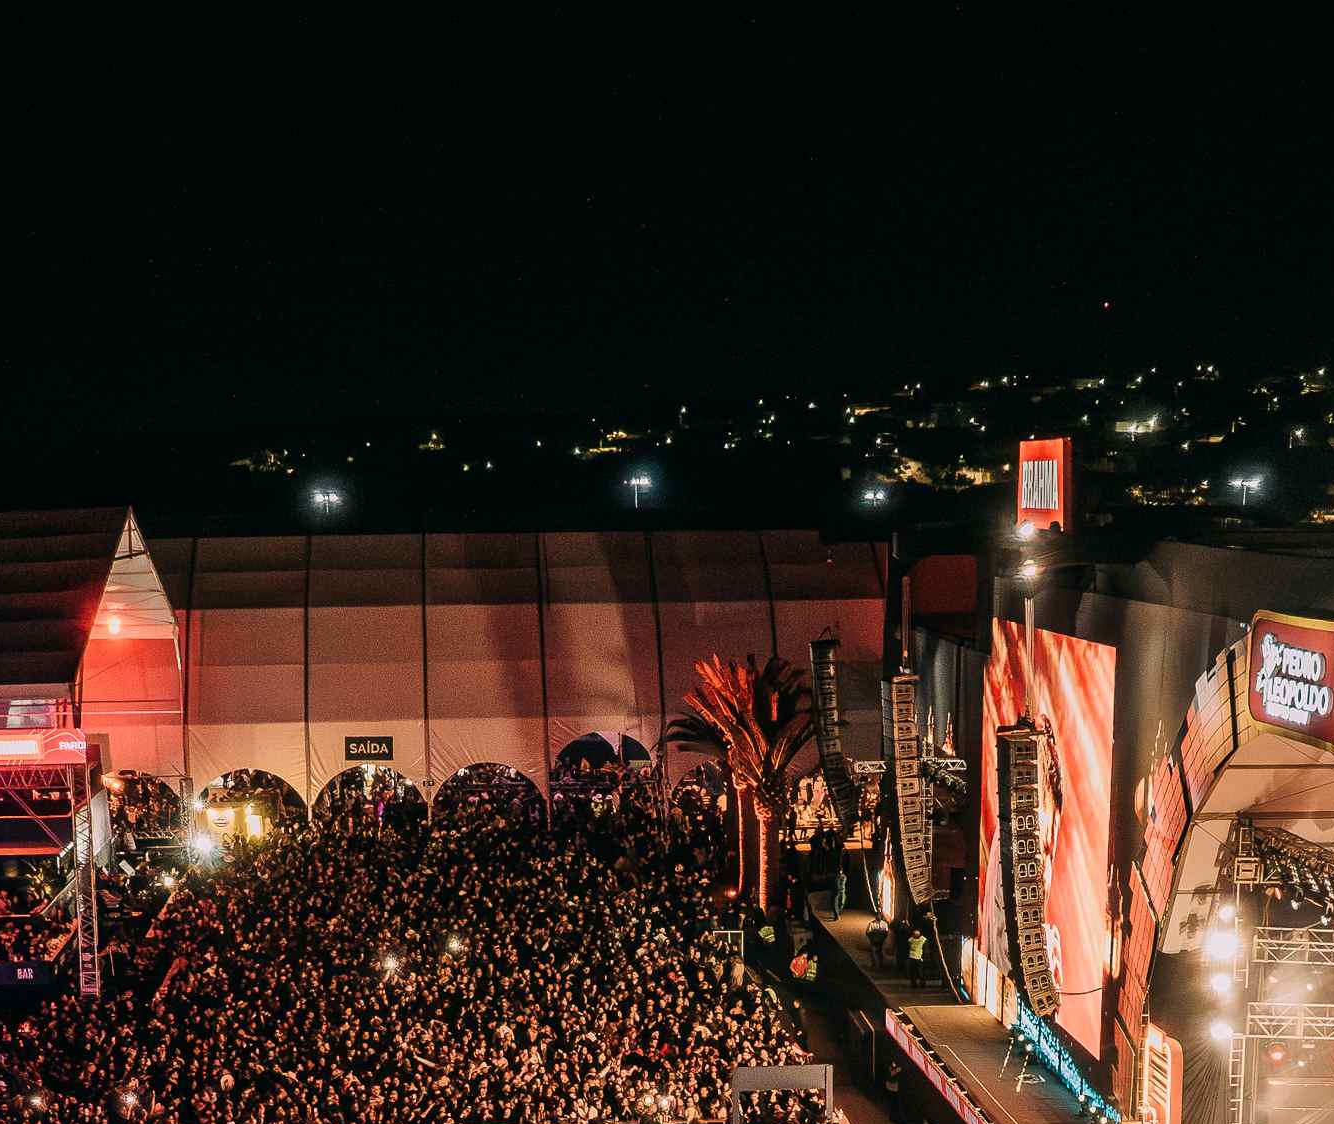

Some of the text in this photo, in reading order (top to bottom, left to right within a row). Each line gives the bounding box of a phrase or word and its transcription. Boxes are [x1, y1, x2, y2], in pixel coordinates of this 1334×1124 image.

[1021, 460, 1059, 510] BRAHMA
[1282, 647, 1324, 682] PEDRO
[1266, 676, 1331, 716] LEOPOLDO
[349, 740, 389, 754] SAÍDA
[17, 968, 34, 979] BAR
